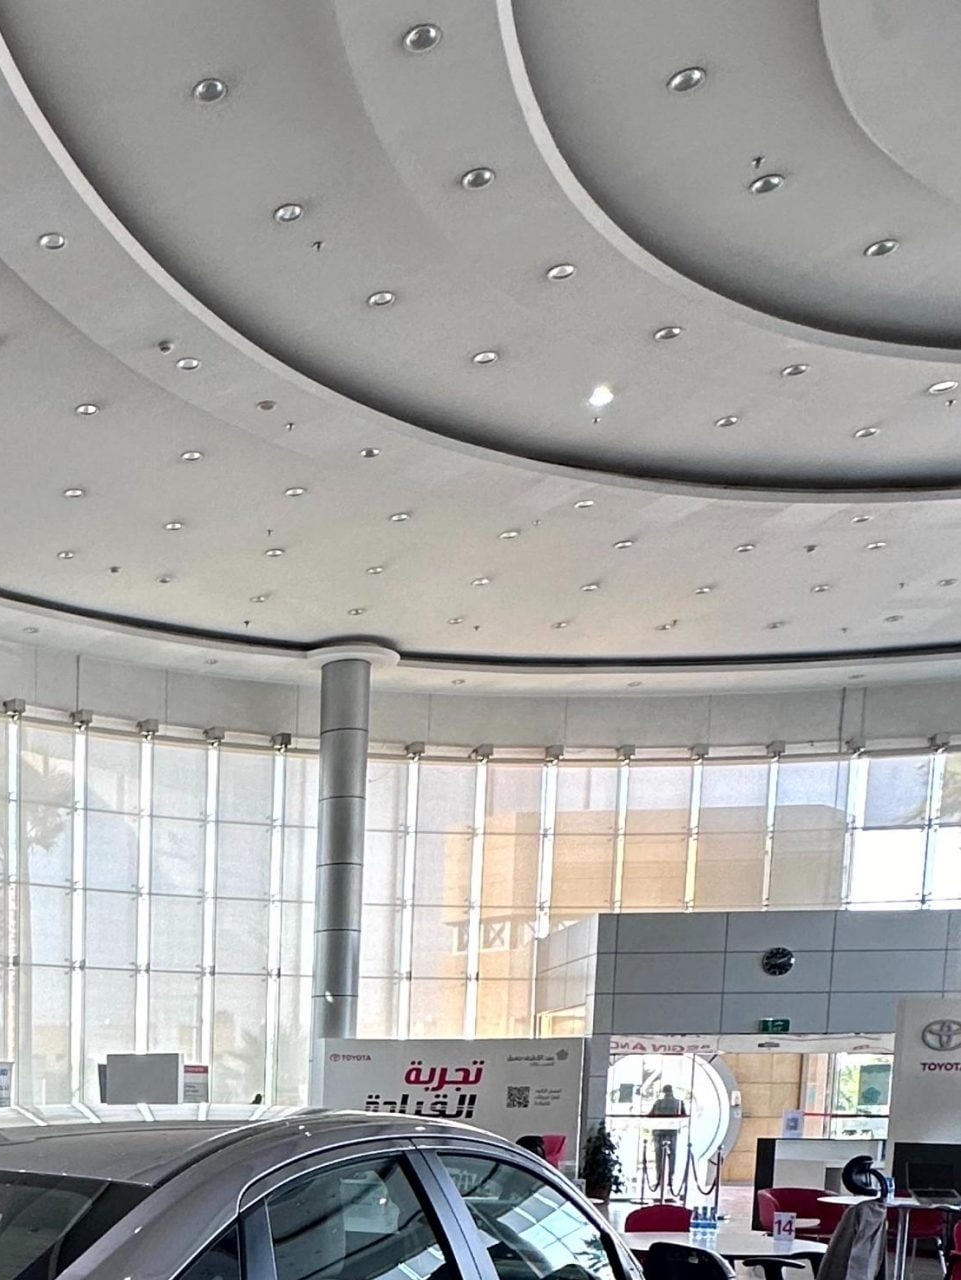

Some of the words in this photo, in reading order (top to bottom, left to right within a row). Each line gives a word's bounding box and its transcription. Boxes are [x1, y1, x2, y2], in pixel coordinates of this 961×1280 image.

[342, 1054, 372, 1062] TOYOTA
[920, 1062, 961, 1072] TOYOT
[404, 1060, 485, 1092] تجربة
[775, 1219, 794, 1236] 14
